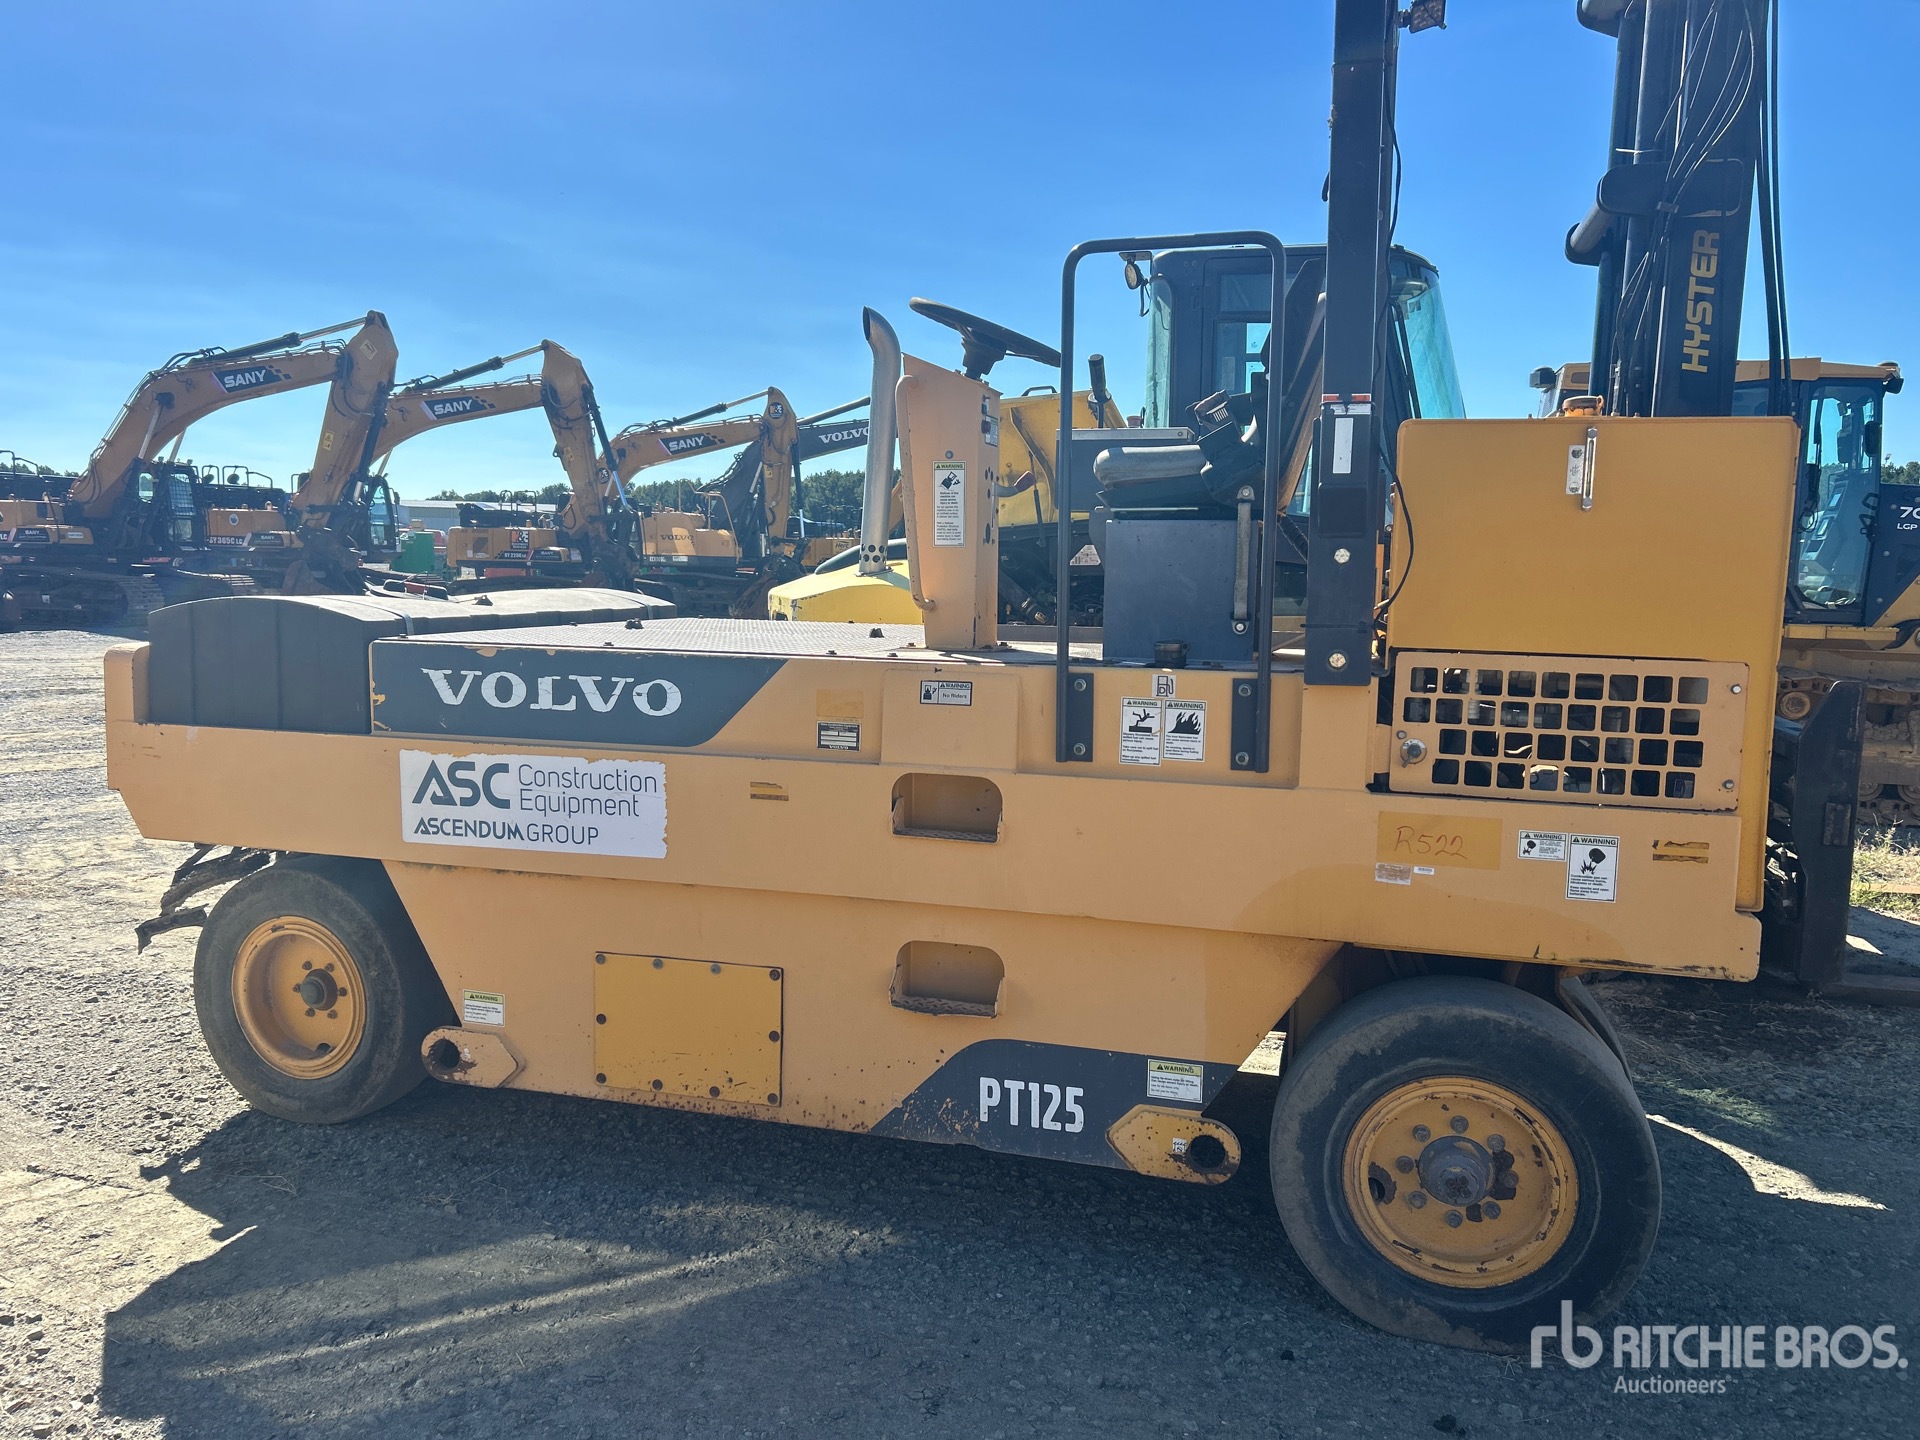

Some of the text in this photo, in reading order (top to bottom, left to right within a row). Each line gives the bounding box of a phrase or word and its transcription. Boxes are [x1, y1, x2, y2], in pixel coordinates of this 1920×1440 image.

[1682, 229, 1720, 373] HYSTER
[224, 370, 266, 388] SANY
[433, 399, 473, 415] SANY
[668, 435, 704, 451] SANY
[421, 667, 682, 717] VOLVO
[1173, 702, 1204, 710] WARNING
[412, 759, 511, 810] ASC
[518, 764, 657, 793] Construction
[520, 788, 640, 818] Equipment
[413, 816, 600, 845] ASCENDUM GROUP
[1394, 825, 1468, 860] R522
[1581, 837, 1617, 845] WARNING
[475, 993, 499, 1002] WARNING
[1163, 1065, 1195, 1073] WARNING
[979, 1076, 1085, 1133] PT125
